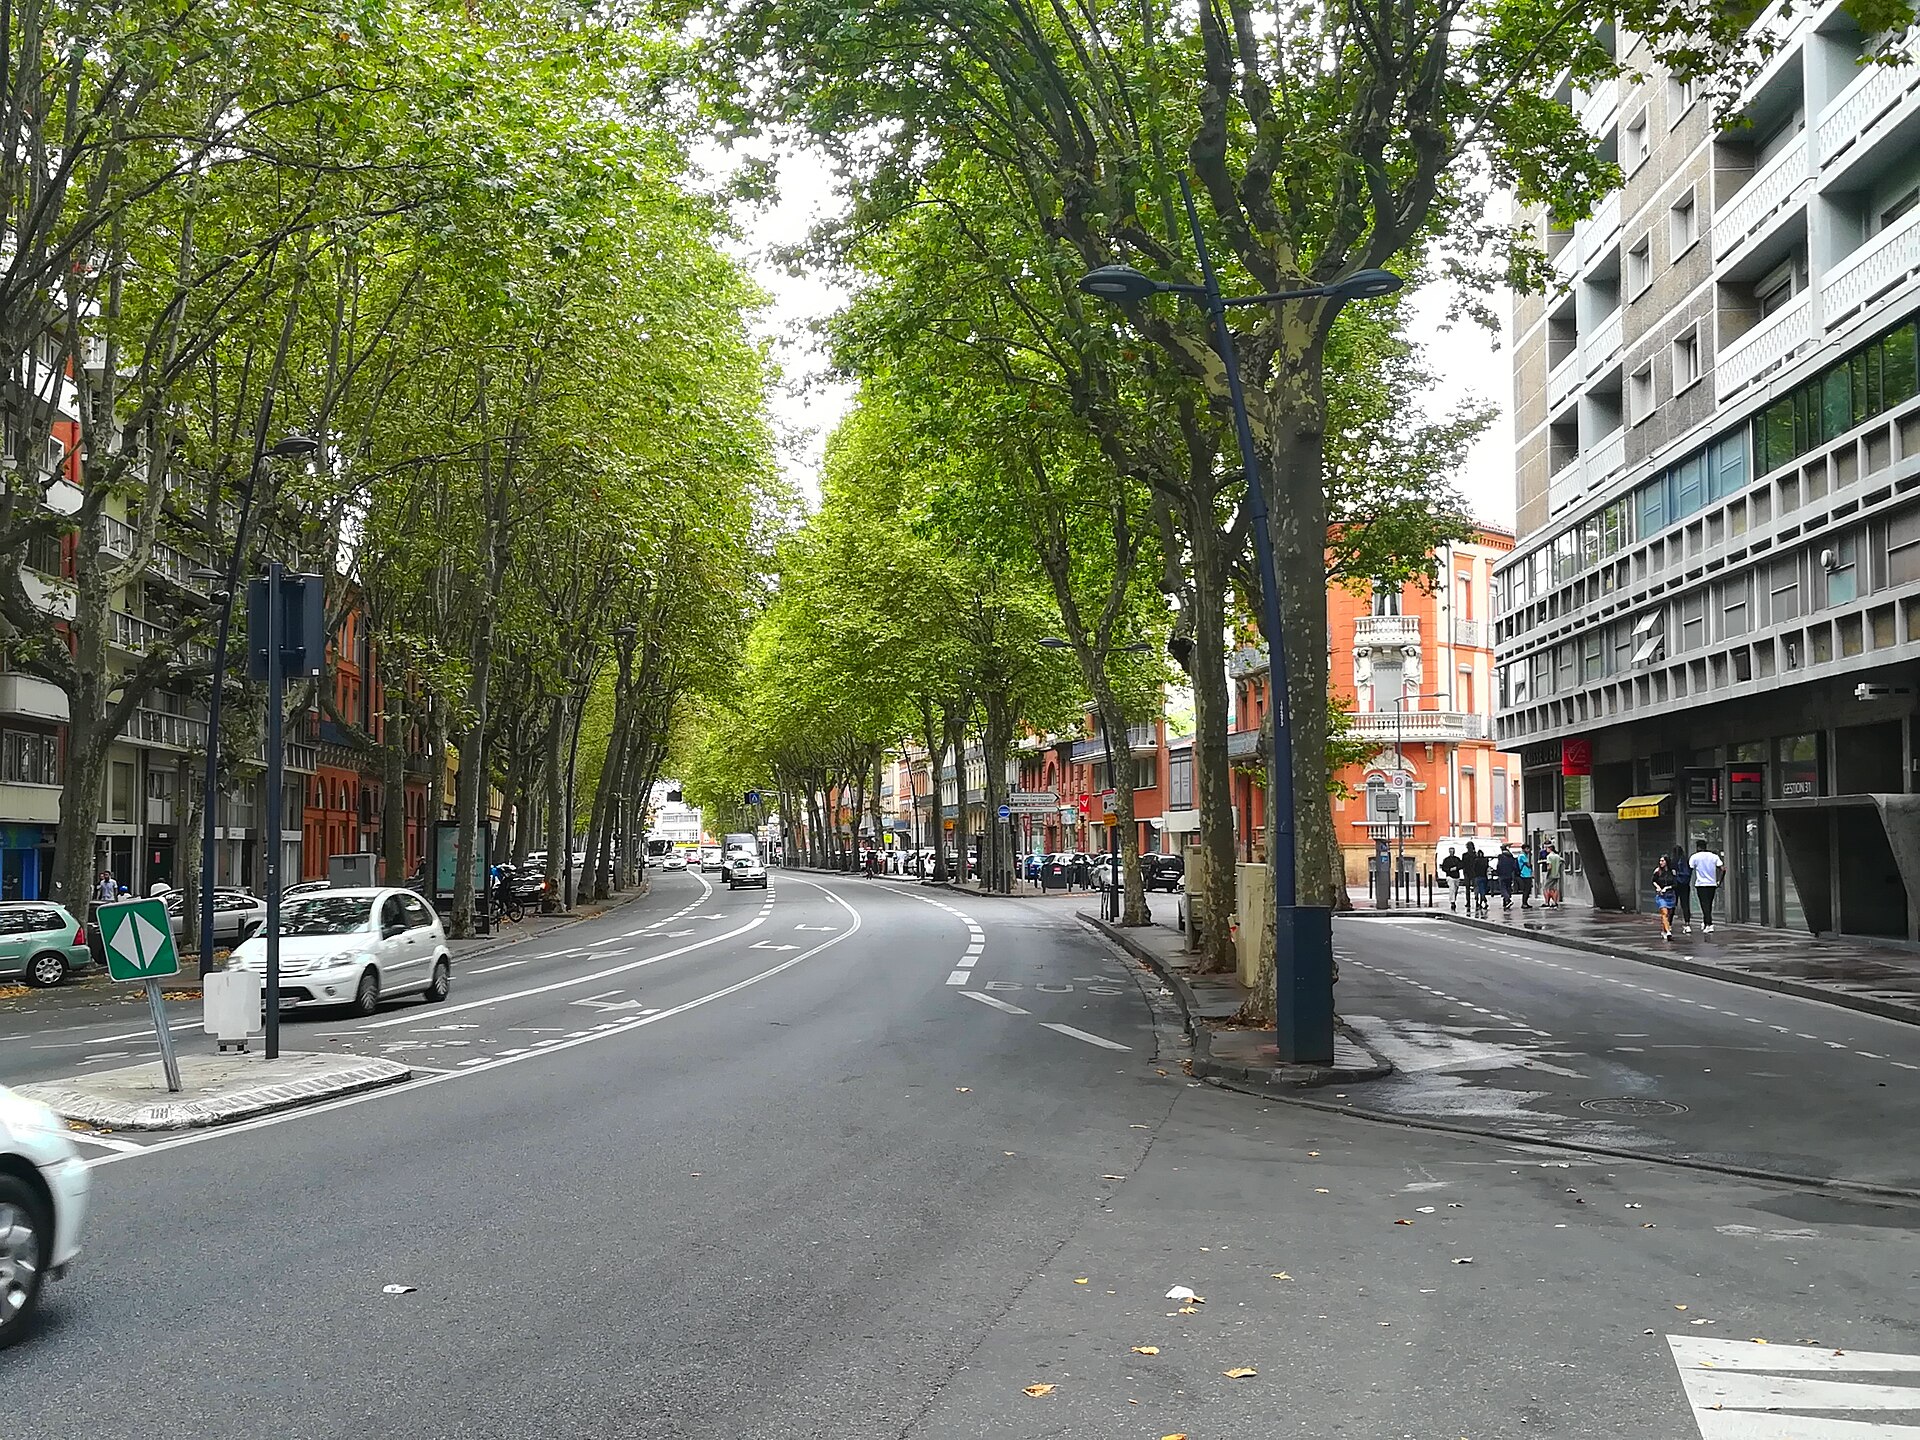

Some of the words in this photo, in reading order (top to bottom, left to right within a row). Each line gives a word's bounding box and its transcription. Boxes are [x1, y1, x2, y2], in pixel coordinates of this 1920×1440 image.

[1783, 782, 1804, 794] GESTION
[1804, 782, 1811, 793] 31
[985, 981, 1123, 996] BUS
